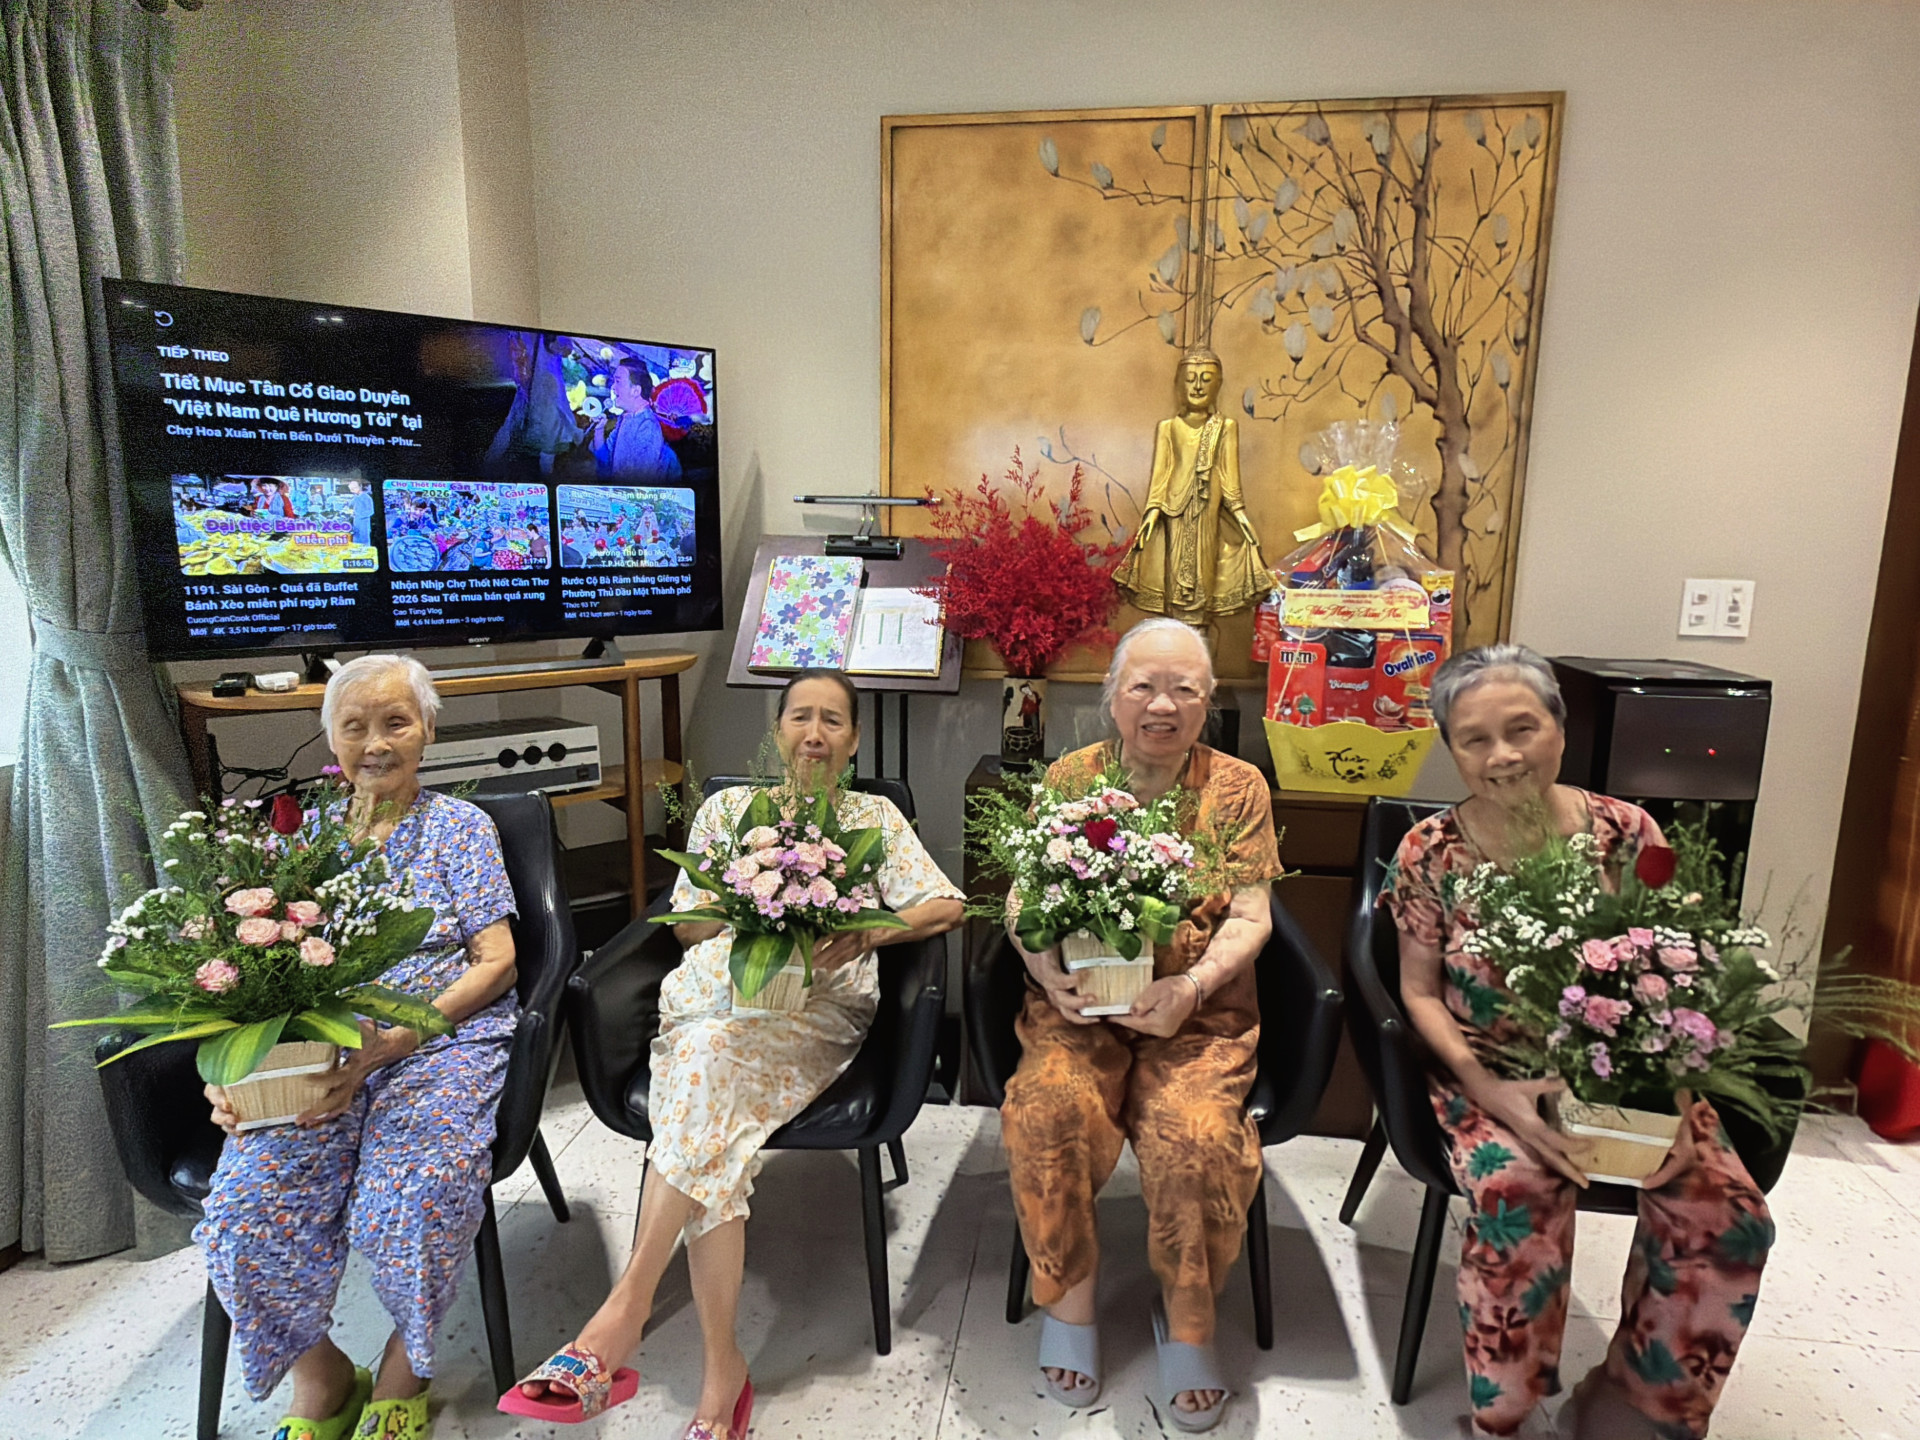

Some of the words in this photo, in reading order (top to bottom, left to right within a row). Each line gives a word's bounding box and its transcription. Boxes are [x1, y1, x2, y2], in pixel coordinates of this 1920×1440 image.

[156, 344, 189, 359] TIẾP
[192, 348, 230, 363] THEO
[160, 372, 200, 391] Tiết
[204, 376, 246, 394] Mục
[249, 380, 285, 397] Tân
[317, 386, 356, 402] Giao
[360, 388, 410, 408] Duyên
[216, 402, 260, 420] Nam
[264, 406, 300, 424] Quê
[303, 409, 362, 428] Hương
[402, 414, 423, 430] tại
[166, 424, 194, 438] Chợ
[196, 426, 222, 438] Hoa
[224, 428, 256, 440] Xuân
[258, 428, 287, 441] Trên
[289, 430, 312, 442] Bến
[315, 432, 342, 443] Dưới
[205, 519, 235, 534] Đại
[275, 519, 316, 532] Bánh
[391, 581, 418, 591] Nhộn
[421, 580, 444, 591] Nhịp
[447, 580, 466, 590] Chợ
[468, 579, 490, 588] Thốt
[493, 579, 510, 587] Nốt
[532, 577, 550, 586] Thơ
[562, 577, 584, 586] Rước
[600, 576, 611, 584] Bà
[633, 575, 655, 584] tháng
[184, 585, 219, 596] 1191.
[222, 584, 242, 594] Sài
[245, 583, 270, 594] Gòn
[280, 583, 303, 593] Quá
[306, 583, 321, 592] đã
[323, 582, 359, 592] Buffet
[562, 589, 596, 599] Phường
[651, 586, 675, 595] Thành
[185, 600, 218, 611] Bánh
[220, 600, 244, 610] Xèo
[280, 598, 298, 610] phí
[300, 598, 328, 609] ngày
[392, 595, 418, 604] 2026
[420, 594, 440, 603] Sau
[442, 593, 460, 602] Tết
[484, 592, 502, 601] bán
[504, 592, 521, 602] quá
[523, 592, 545, 601] xung
[212, 627, 224, 635] 4K
